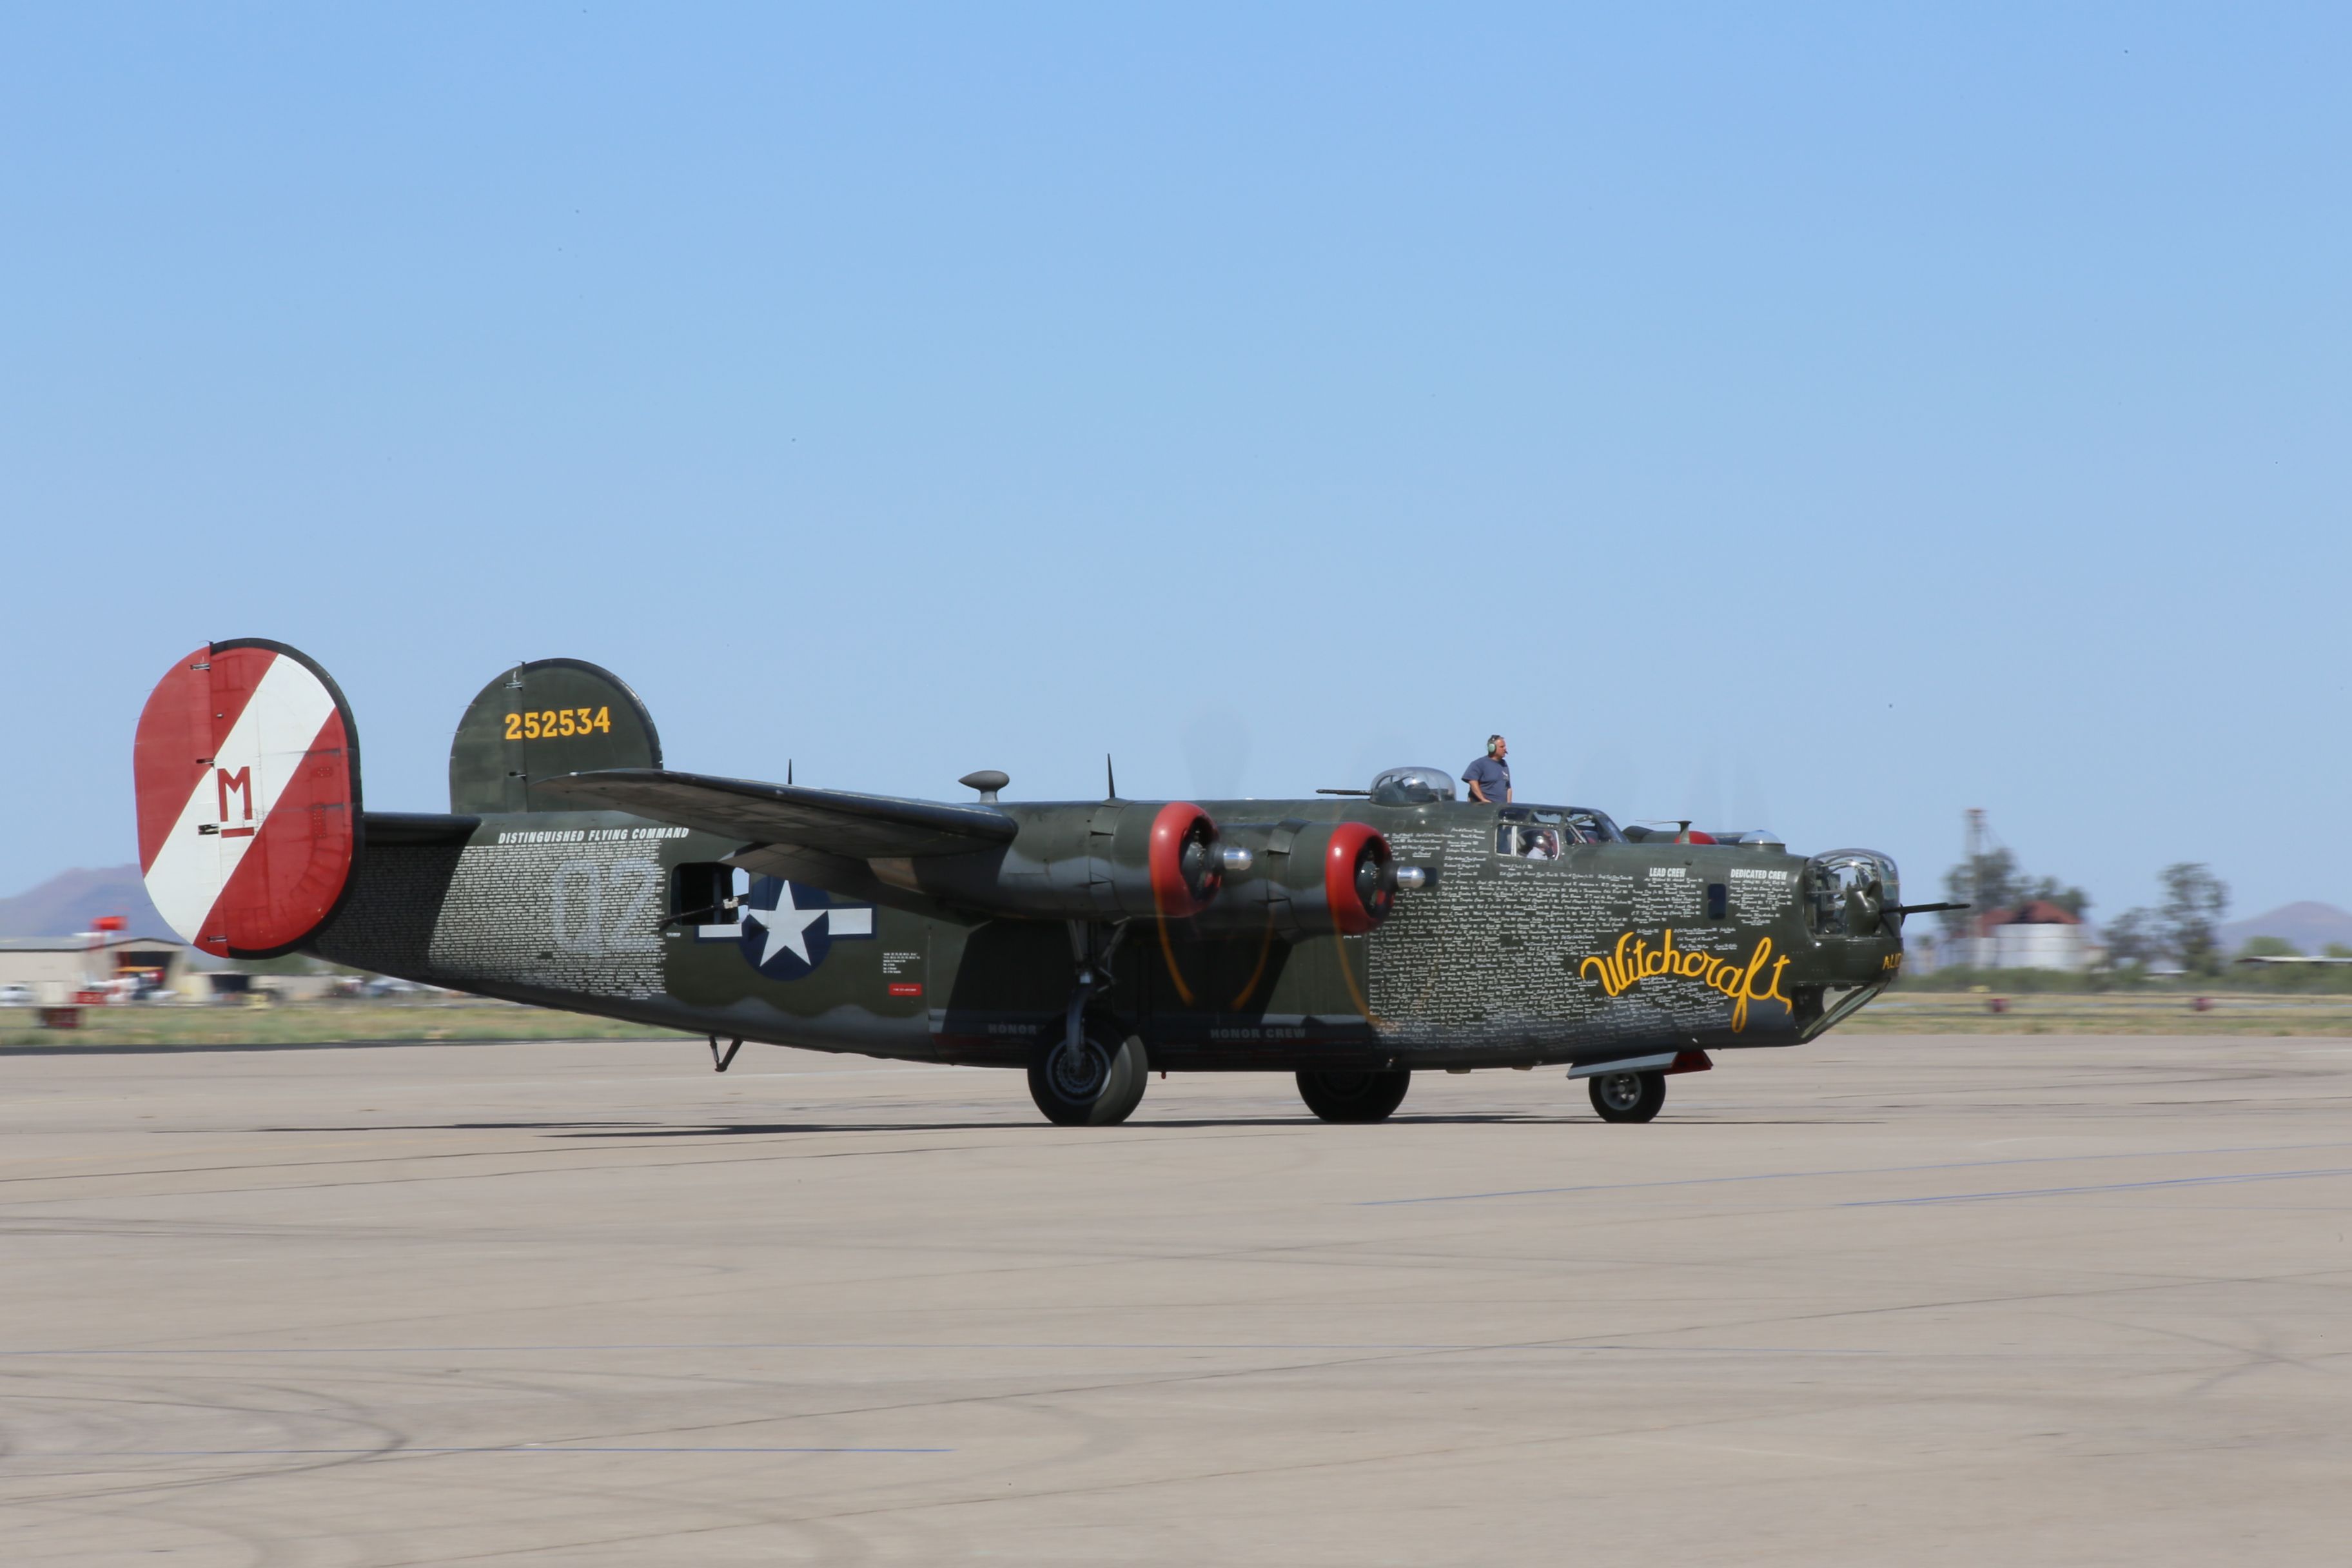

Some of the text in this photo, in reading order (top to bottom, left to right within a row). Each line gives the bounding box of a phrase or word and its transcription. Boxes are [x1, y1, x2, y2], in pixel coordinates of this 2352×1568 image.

[505, 706, 611, 740] 252534
[217, 766, 253, 822] M
[498, 827, 690, 844] DISTINGUISHED FLYING COMMAND
[1649, 867, 1687, 878] LEAD CREW
[1730, 868, 1788, 881] DEDICATED CREW
[1580, 928, 1792, 1033] Witchcraft
[987, 1023, 1037, 1035] HONOR
[1210, 1028, 1306, 1039] HONOR CREW
